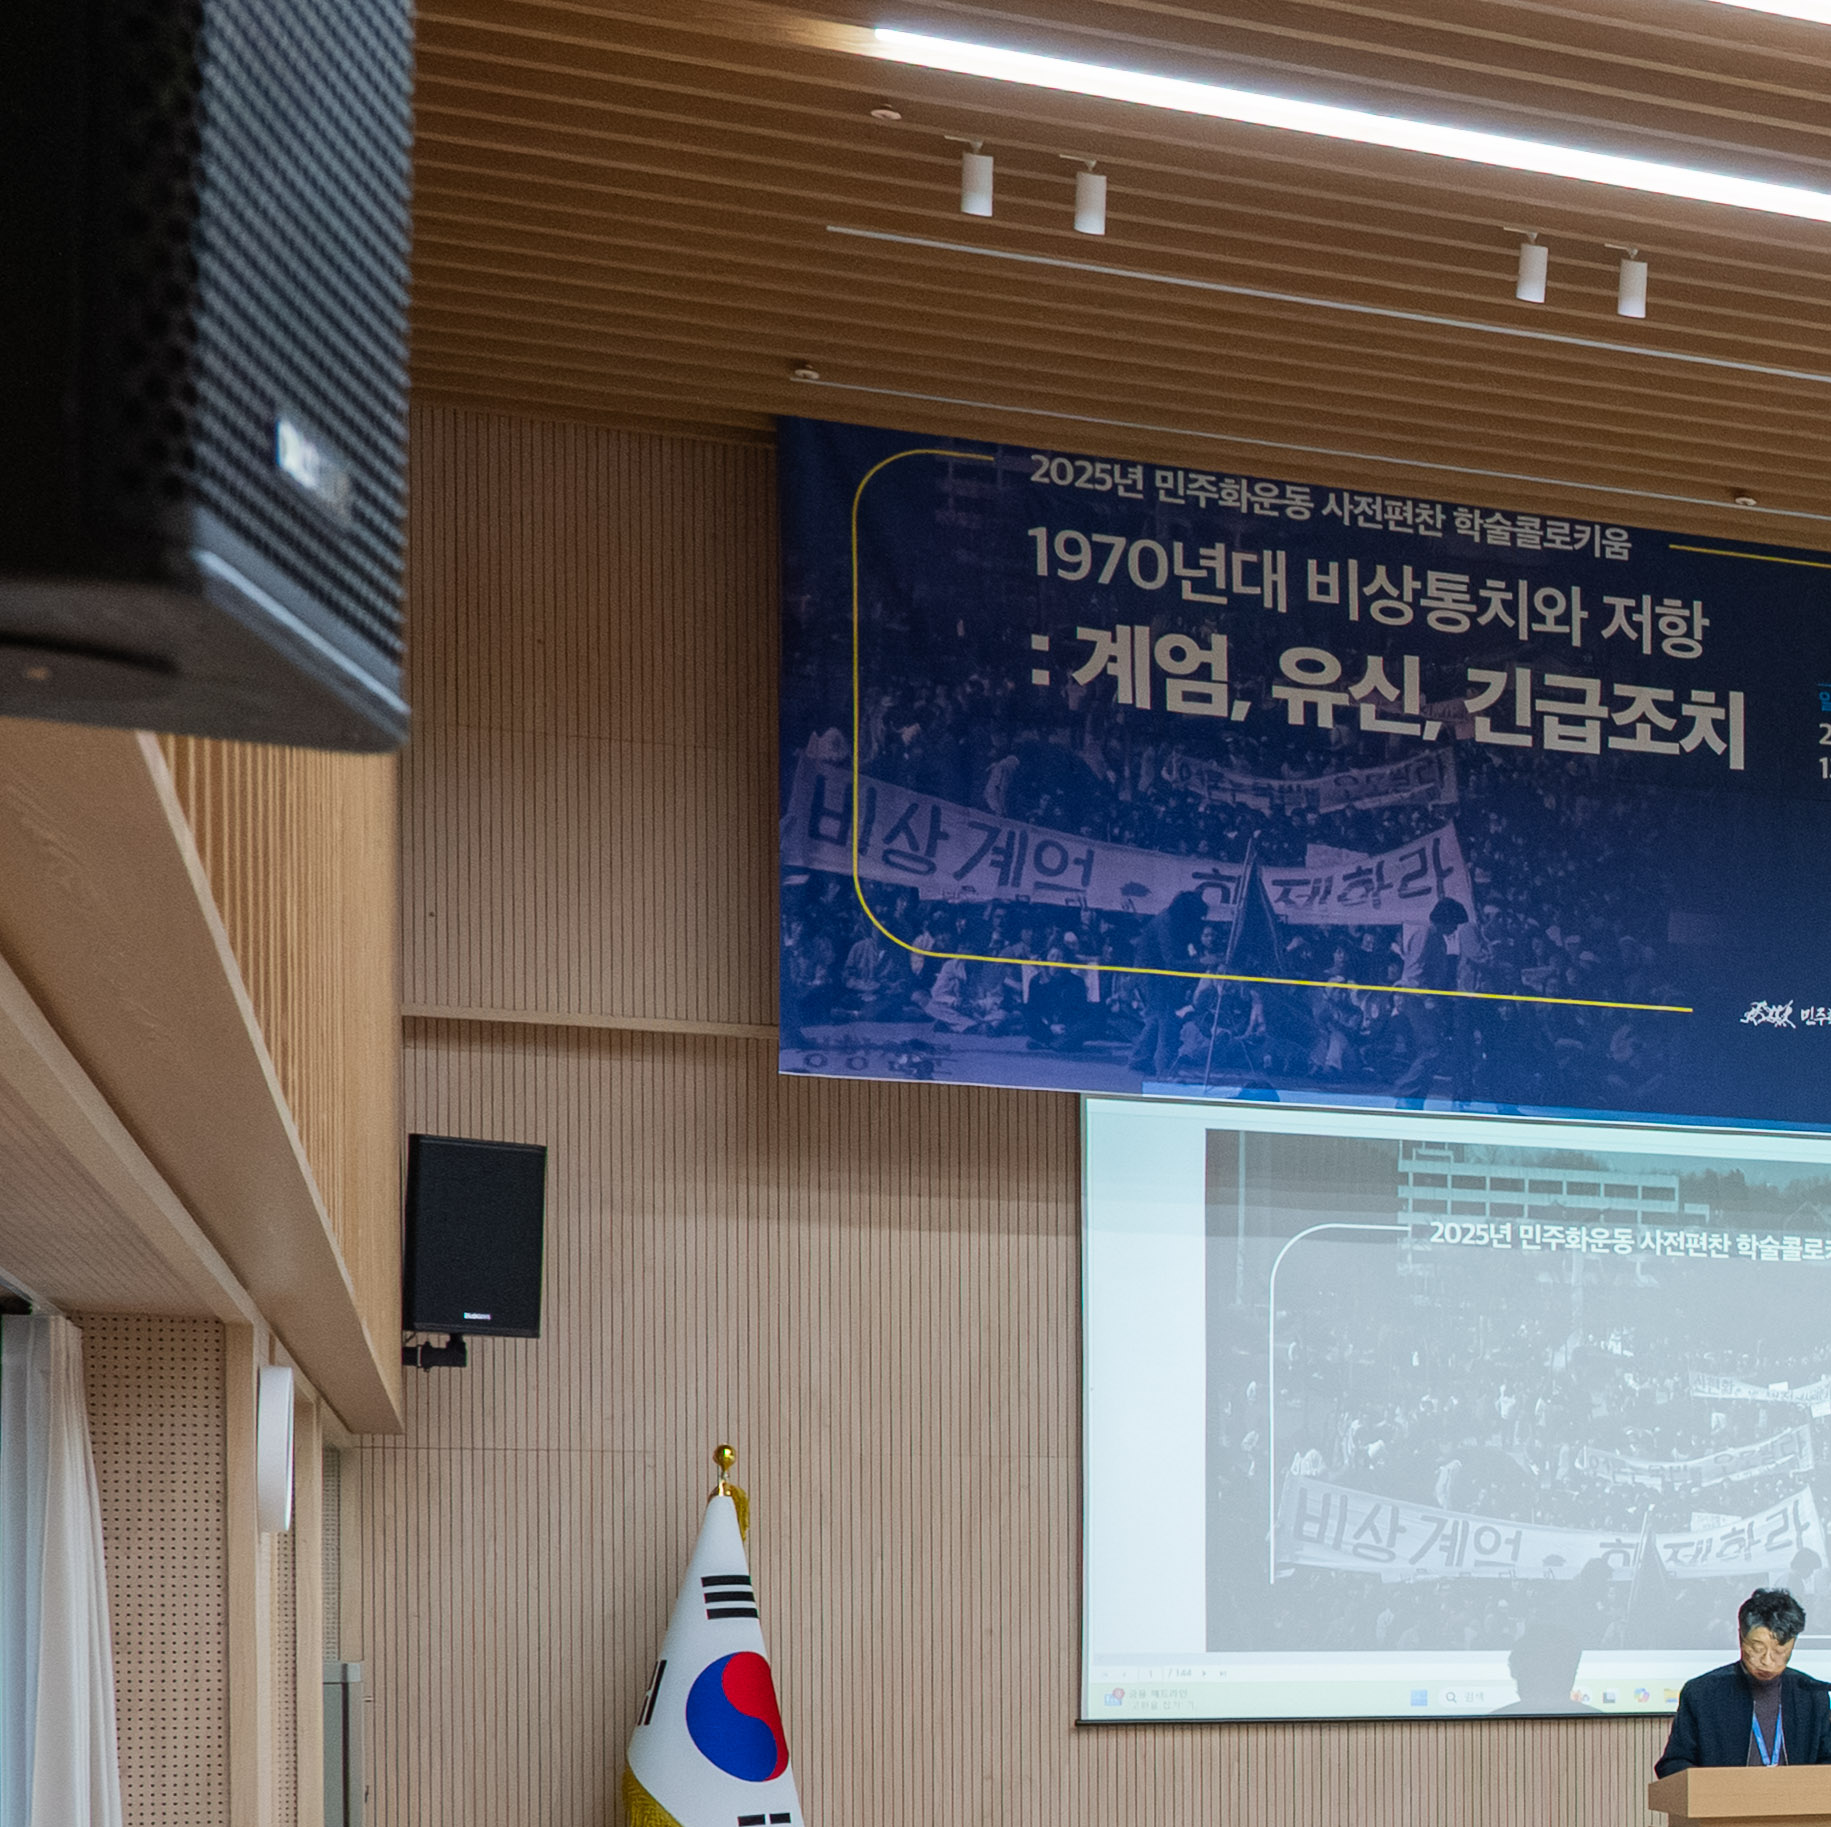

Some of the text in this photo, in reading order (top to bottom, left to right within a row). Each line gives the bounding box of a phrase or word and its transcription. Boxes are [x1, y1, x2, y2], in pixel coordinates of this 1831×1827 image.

[1030, 454, 1633, 561] 2025년 민주화운동 사전편찬 학술콜로키움
[1027, 526, 1710, 661] 1970년대 비상통치와 저항
[1073, 620, 1252, 724] 계엄,
[1272, 647, 1443, 743] 유신,
[1465, 665, 1745, 771] 긴급조치
[1430, 1219, 1512, 1250] 2025년
[1518, 1224, 1636, 1256] 민주화운동
[1639, 1231, 1731, 1260] 사전편찬
